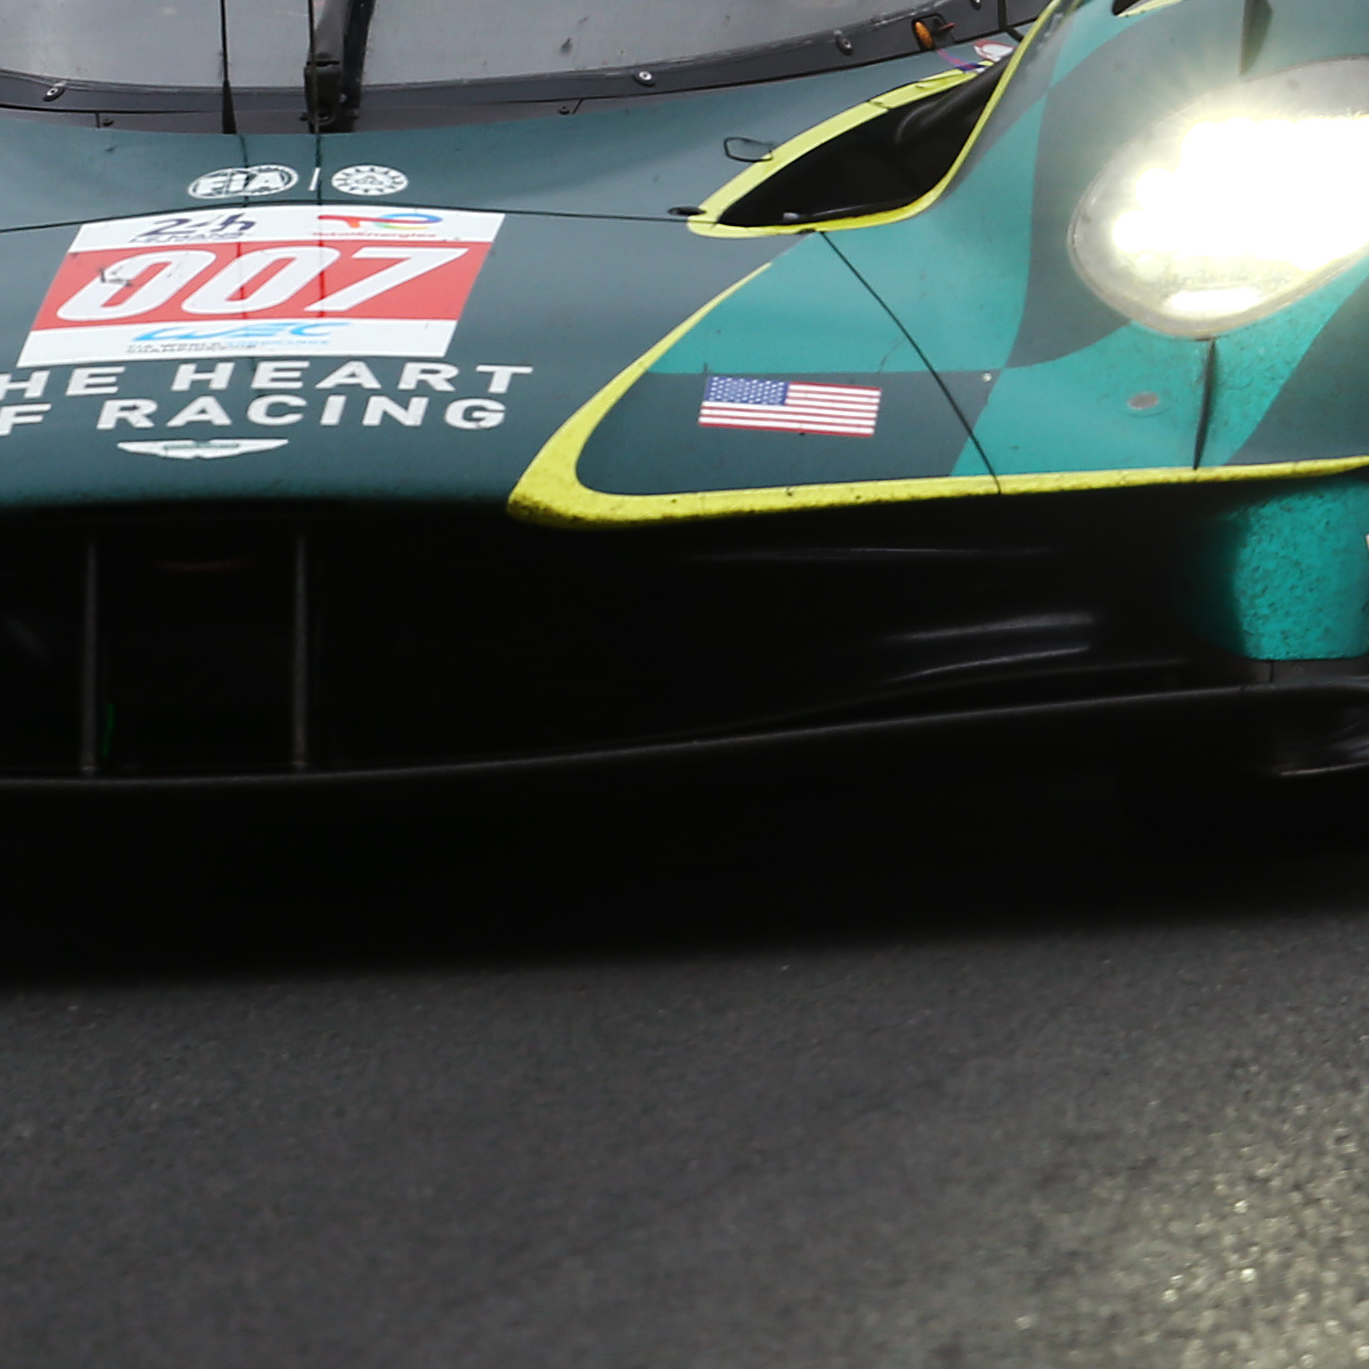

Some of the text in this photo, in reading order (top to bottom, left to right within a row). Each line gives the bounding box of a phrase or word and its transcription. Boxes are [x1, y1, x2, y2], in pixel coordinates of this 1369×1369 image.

[192, 168, 292, 197] FIA
[56, 246, 469, 321] 007
[132, 321, 352, 341] WEC
[171, 360, 533, 394] HEART
[96, 394, 509, 430] RACING
